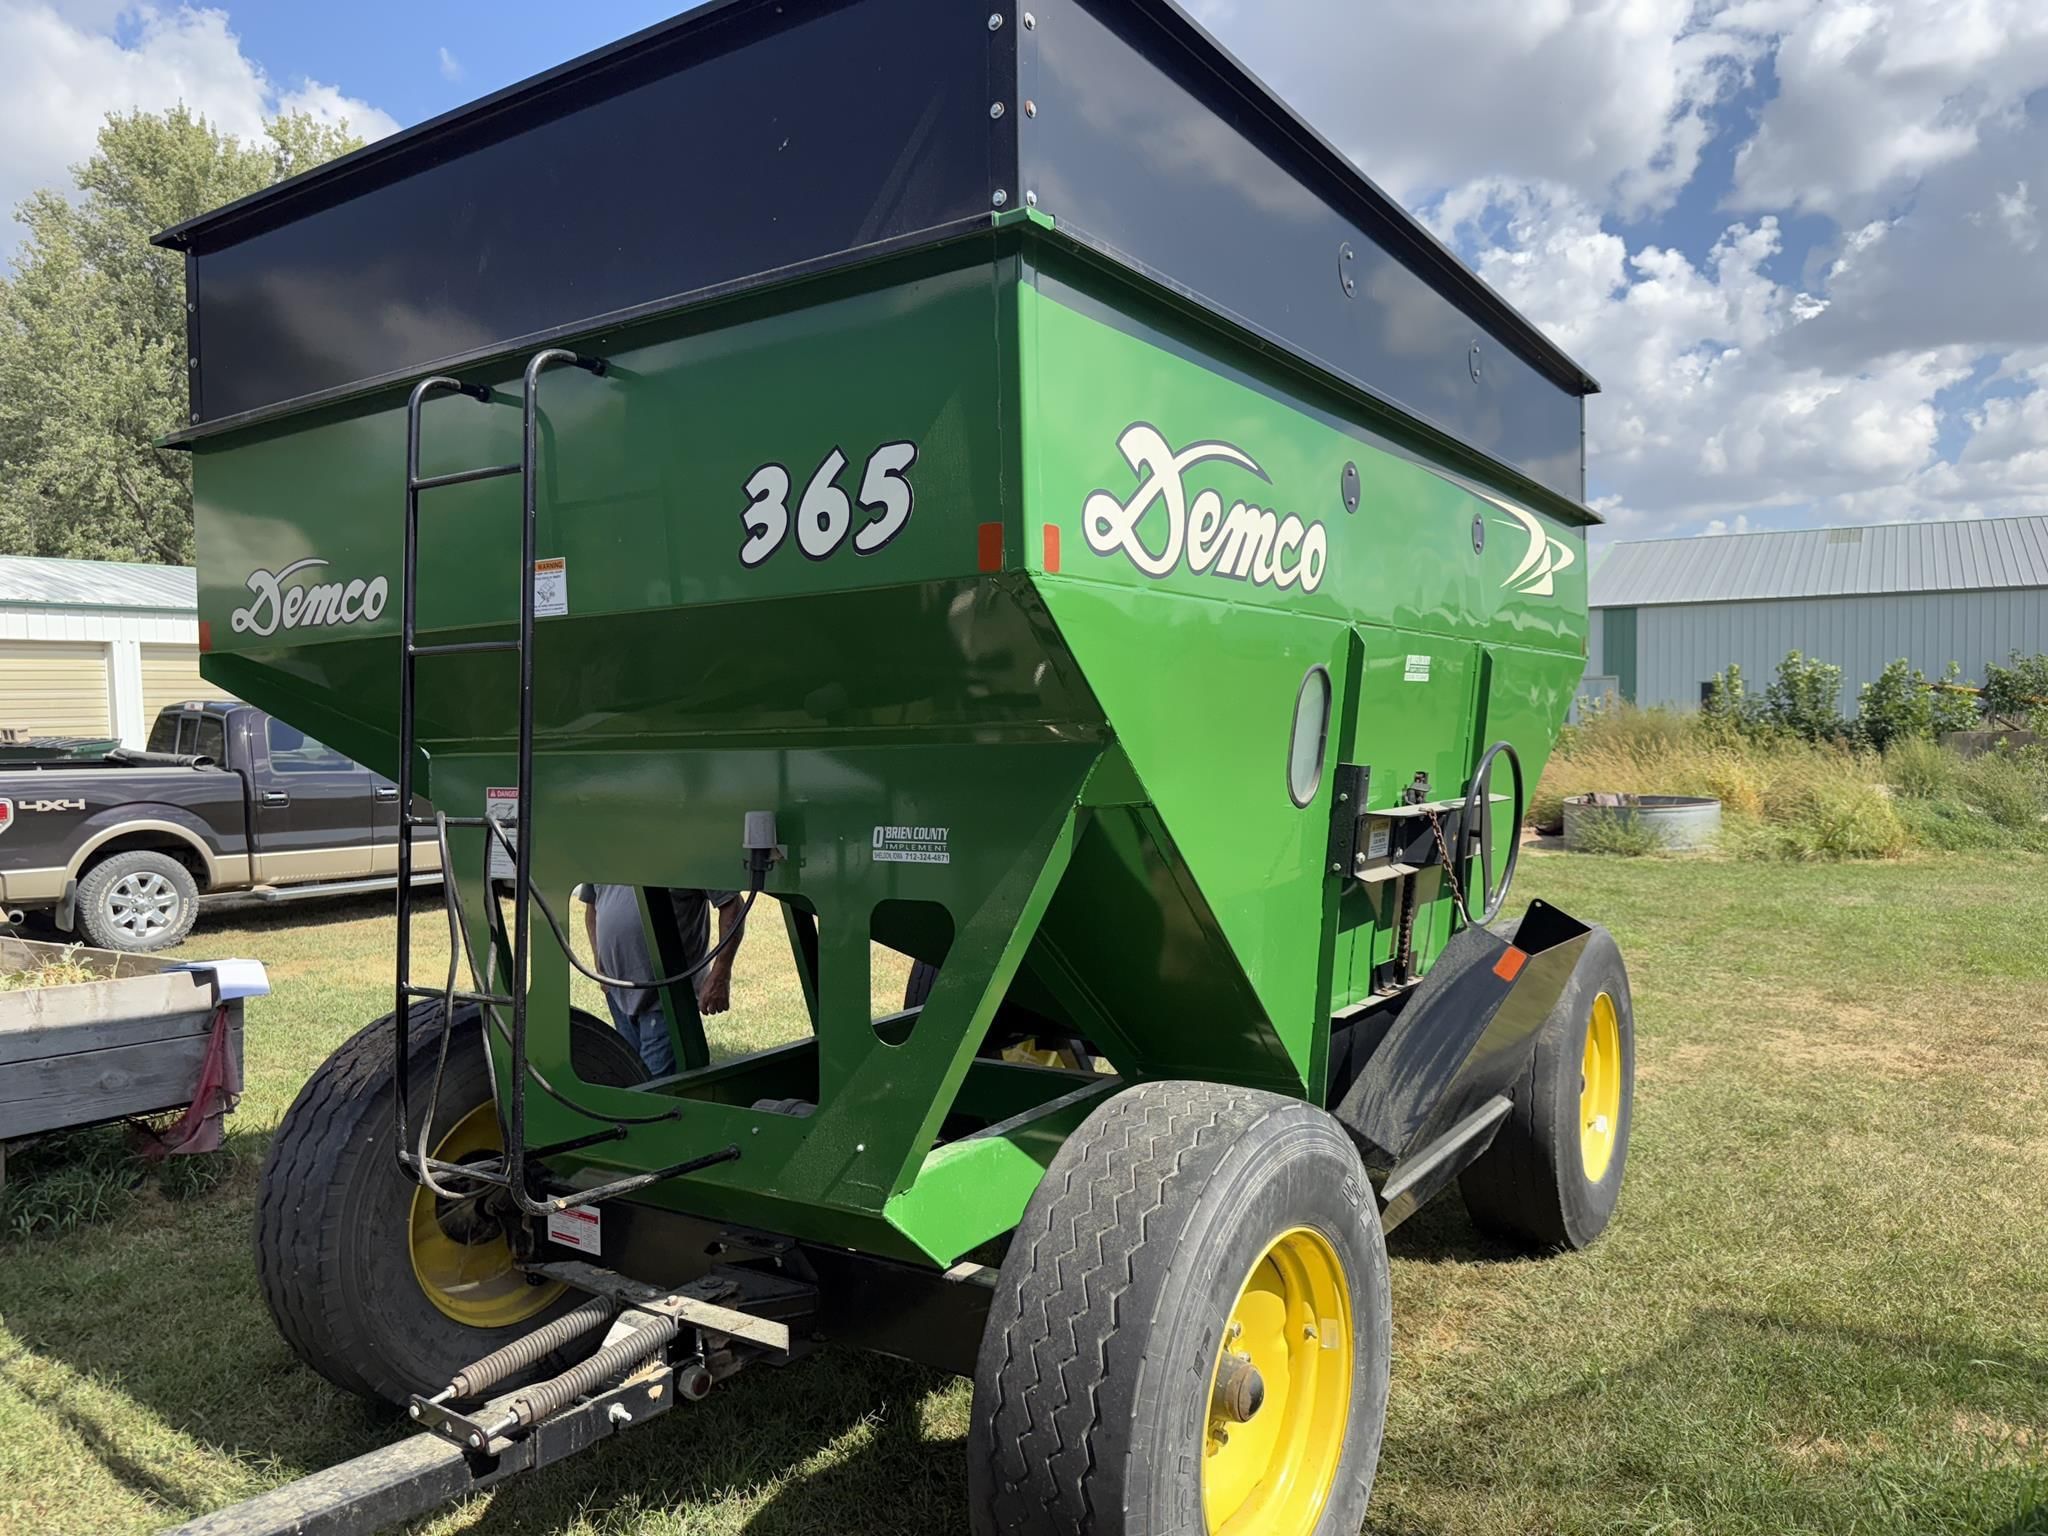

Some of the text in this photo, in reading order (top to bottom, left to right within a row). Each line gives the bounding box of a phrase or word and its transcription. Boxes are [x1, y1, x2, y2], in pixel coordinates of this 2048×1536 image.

[738, 439, 919, 569] 365
[1082, 420, 1327, 594] Demco
[232, 557, 388, 637] Demco
[885, 843, 948, 852] IMPLEMENT
[905, 852, 949, 862] 712-324-4871
[913, 827, 950, 841] COUNTY
